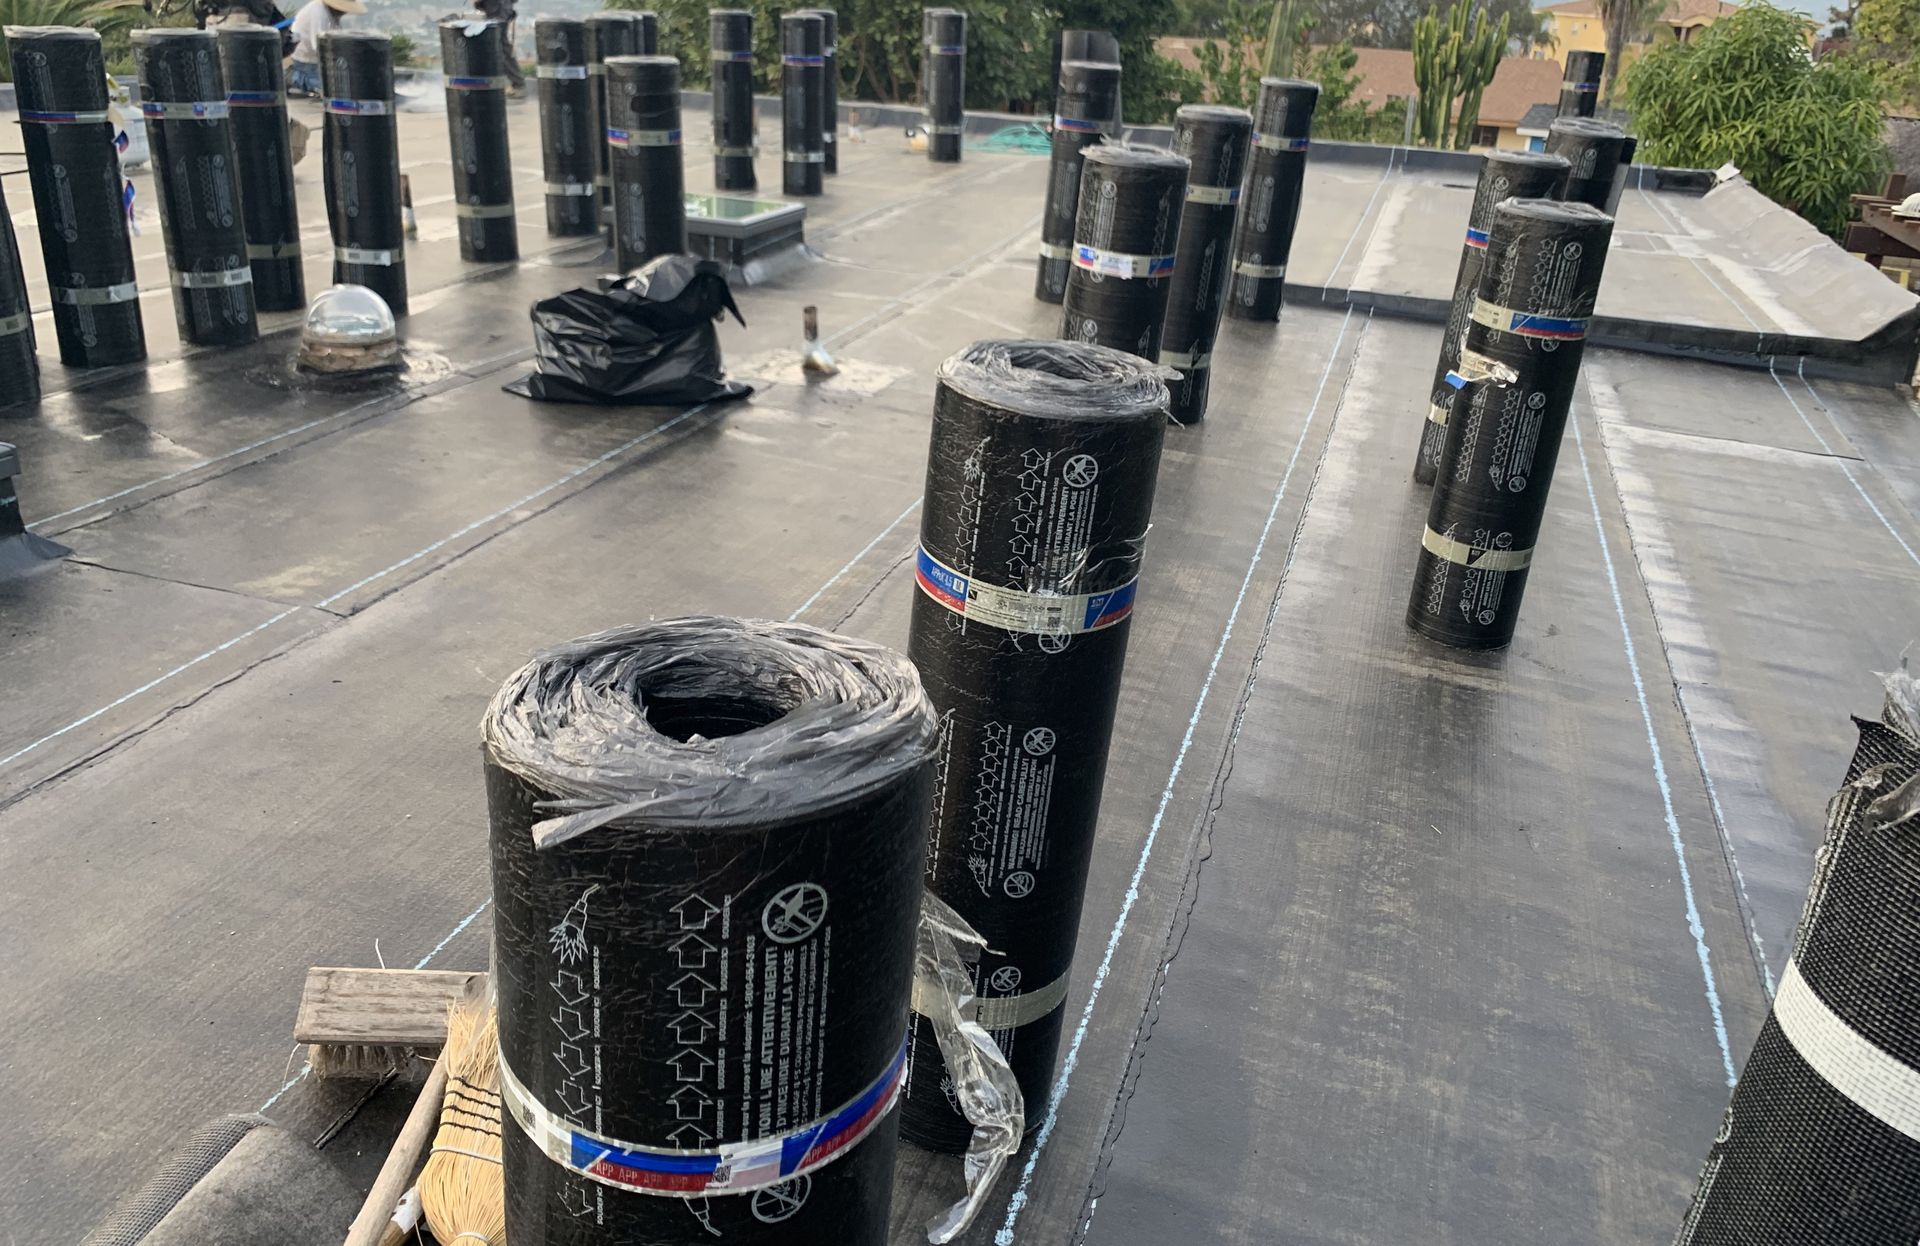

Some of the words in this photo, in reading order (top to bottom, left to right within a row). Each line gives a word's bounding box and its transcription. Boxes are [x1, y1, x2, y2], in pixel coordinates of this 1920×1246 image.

[1066, 510, 1074, 521] LA
[1068, 490, 1078, 510] POSE
[1053, 486, 1069, 555] ATTENTIVEMENT!
[1061, 521, 1073, 552] DURANT
[1016, 758, 1029, 805] CAREFULLY!
[1025, 758, 1038, 803] INSTALLATION
[1013, 807, 1022, 829] READ
[1022, 803, 1032, 828] DURING
[1007, 829, 1019, 870] WARNING!
[1018, 829, 1028, 855] HAZARD
[783, 948, 795, 984] POSE
[761, 945, 778, 1065] ATTENTIVEMENT!
[782, 984, 794, 1003] LA
[779, 1005, 793, 1056] DURANT
[760, 1066, 773, 1100] LIRE
[777, 1056, 790, 1127] D'INCENDIE
[596, 1161, 614, 1177] APP
[618, 1168, 638, 1183] APP
